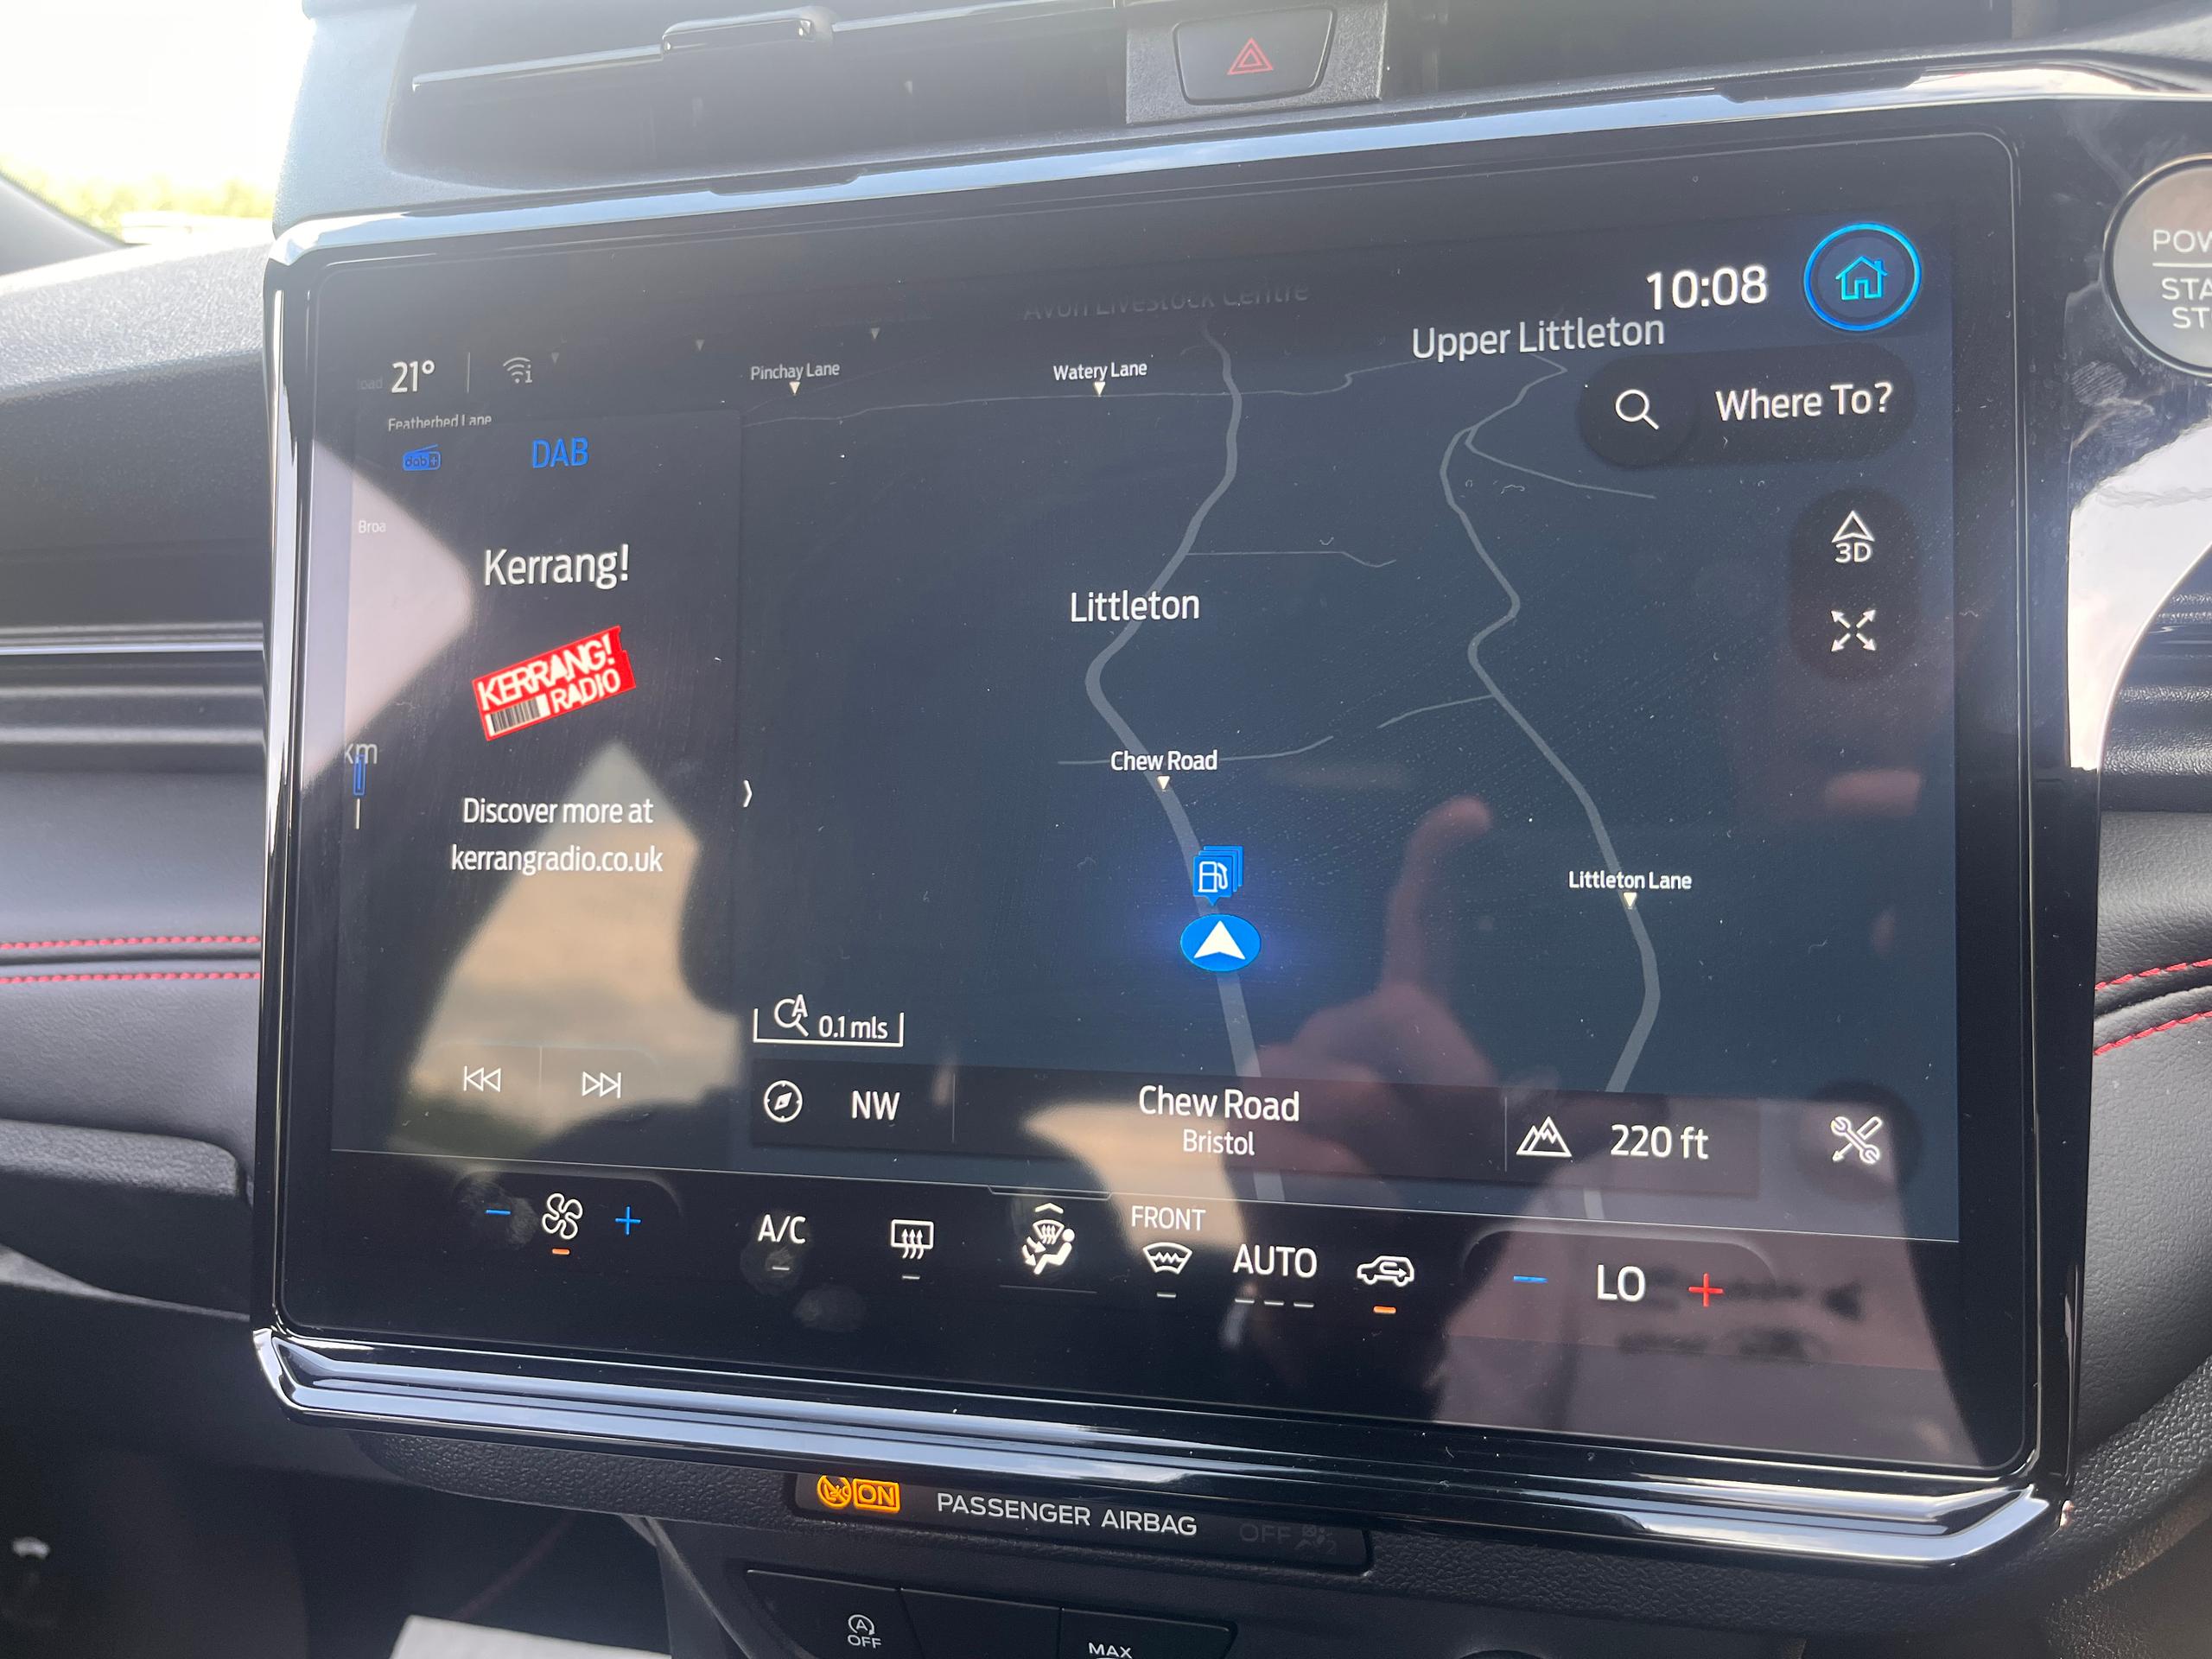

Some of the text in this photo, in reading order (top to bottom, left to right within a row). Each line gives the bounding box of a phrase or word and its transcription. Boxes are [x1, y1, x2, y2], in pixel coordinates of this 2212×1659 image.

[1646, 265, 1768, 310] 10:08
[2171, 305, 2212, 329] ST
[1411, 315, 1665, 362] Upper Littleton
[391, 359, 435, 394] 21°
[750, 360, 840, 382] Pinchay Lane
[1053, 360, 1147, 382] Watery Lane
[1714, 381, 1893, 422] Where To?
[531, 436, 589, 468] DAB
[483, 543, 630, 590] Kerrang!
[1834, 542, 1872, 563] 3D
[1070, 590, 1201, 623] Littleton
[477, 632, 616, 712] KERRANG!
[549, 667, 622, 714] RADIO
[1110, 749, 1218, 772] Chew Road
[463, 798, 655, 823] Discover more at
[451, 842, 664, 876] kerrangradio.co.uk
[1568, 871, 1693, 890] Littleton Lane
[818, 1014, 889, 1039] 0.1 mls
[851, 1090, 900, 1122] NW
[1139, 1085, 1300, 1122] Chew Road
[1183, 1128, 1255, 1156] Bristol
[1610, 1124, 1709, 1160] 220 ft
[757, 1213, 807, 1246] A/C
[1130, 1205, 1207, 1233] FRONT
[1231, 1243, 1318, 1279] AUTO
[1597, 1264, 1647, 1302] LO
[858, 1484, 895, 1506] ON
[937, 1492, 1198, 1536] PASSENGER AIRBAG
[1238, 1522, 1293, 1544] OFF
[846, 1633, 883, 1649] OFF
[1087, 1641, 1133, 1659] MAX
